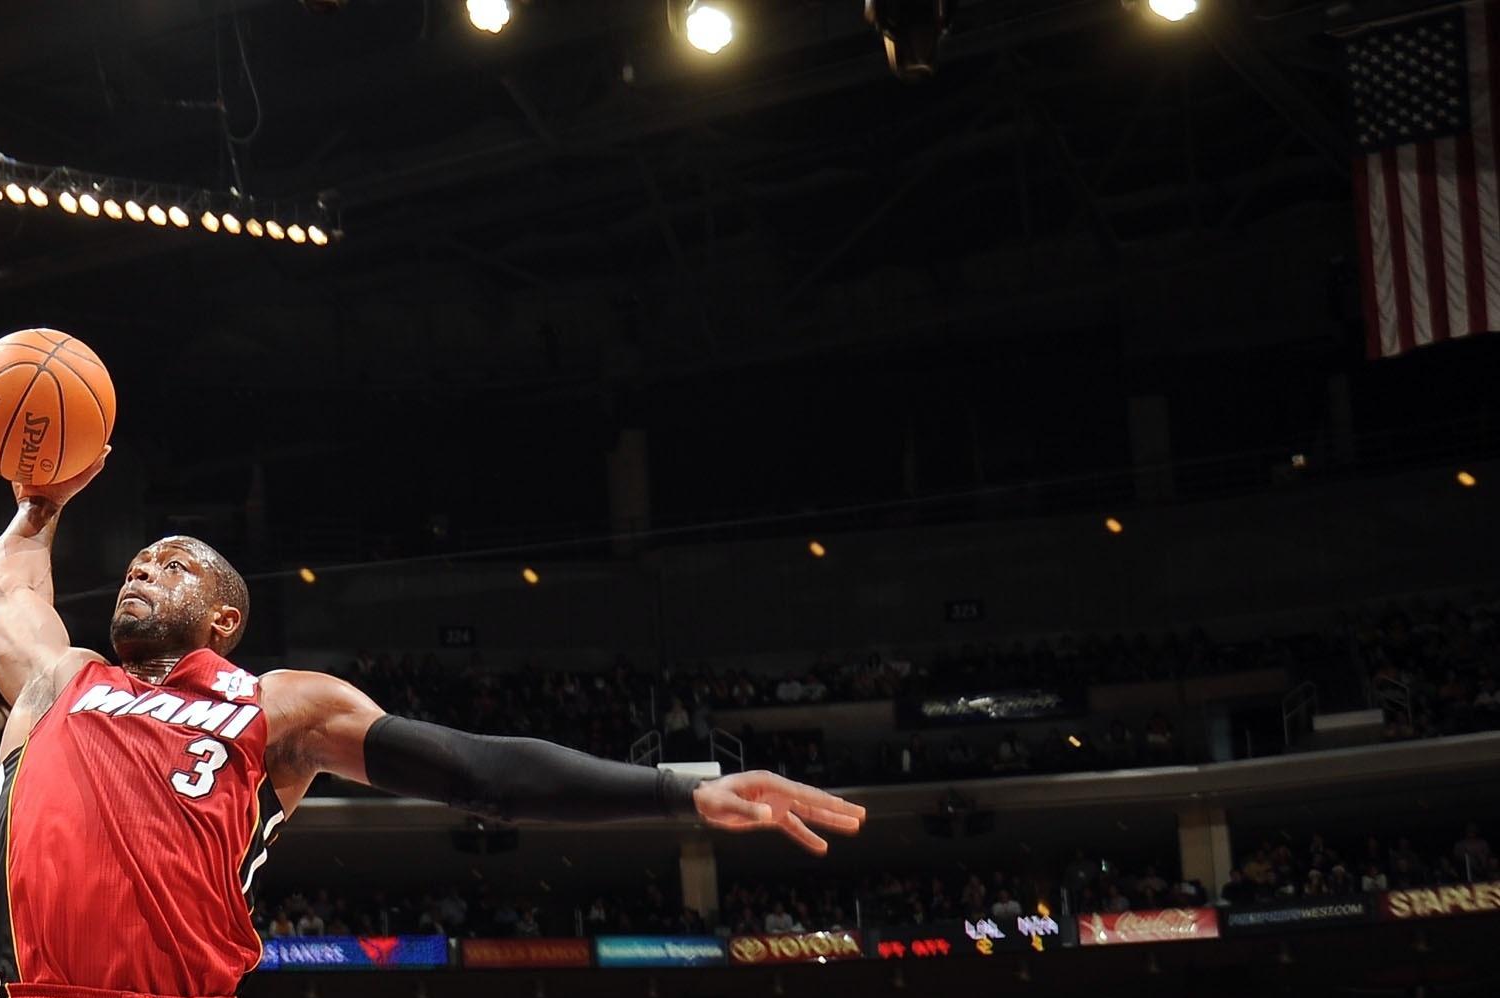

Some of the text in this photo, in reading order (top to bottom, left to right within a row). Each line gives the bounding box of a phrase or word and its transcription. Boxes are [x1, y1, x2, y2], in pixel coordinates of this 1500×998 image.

[68, 683, 263, 740] MIAMI
[169, 735, 229, 799] 3
[767, 934, 861, 959] TOYOTA
